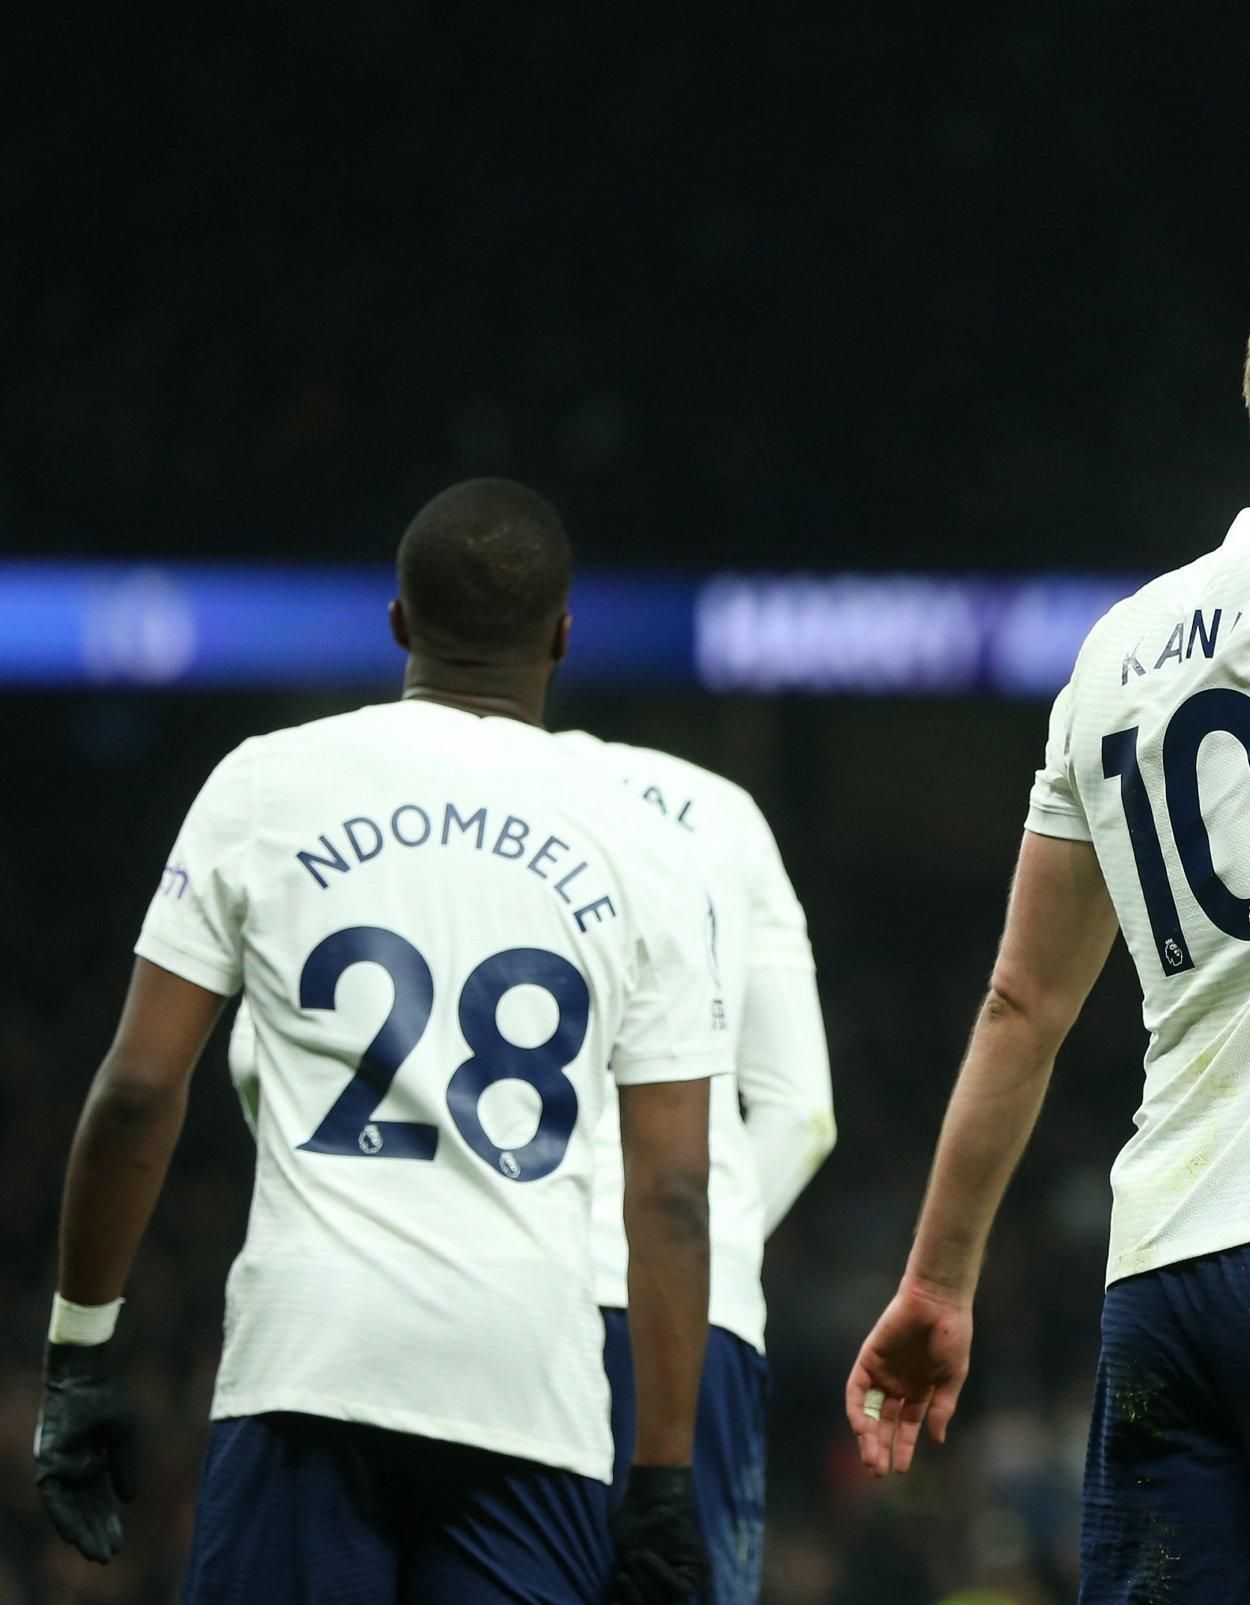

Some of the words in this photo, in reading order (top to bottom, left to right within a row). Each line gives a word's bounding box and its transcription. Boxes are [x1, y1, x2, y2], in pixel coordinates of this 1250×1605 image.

[1121, 608, 1243, 687] KAN
[296, 801, 619, 934] NDOMBELE
[296, 925, 591, 1183] 28
